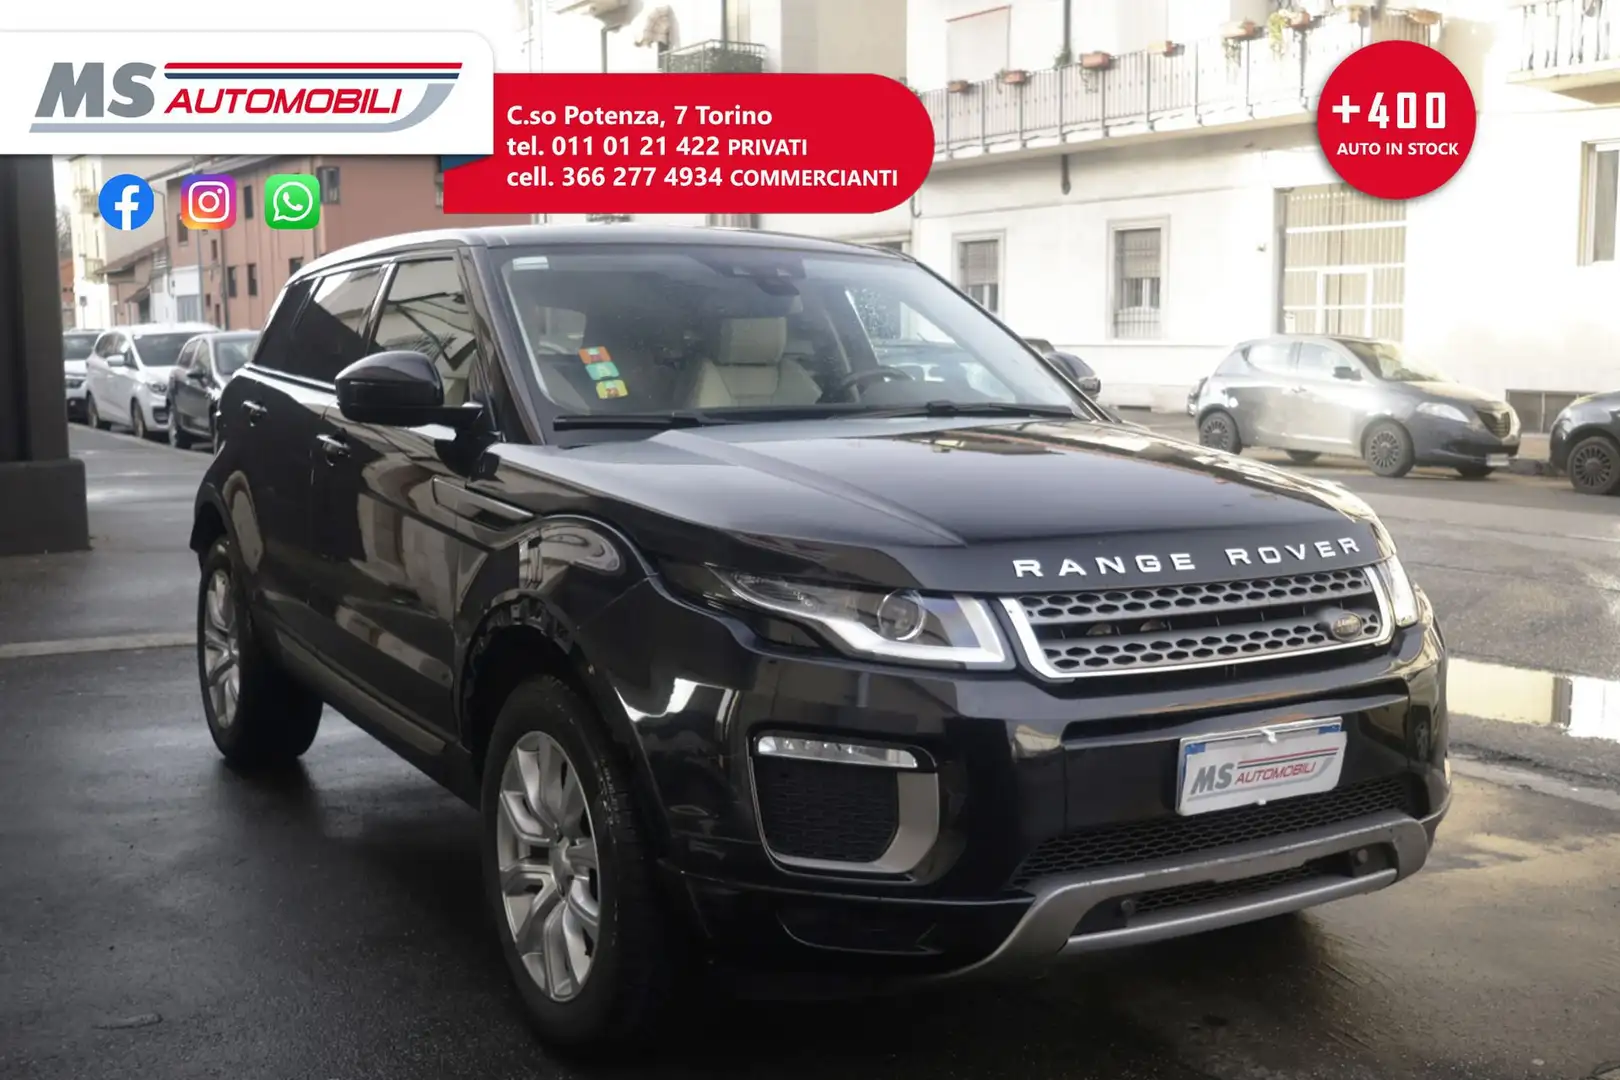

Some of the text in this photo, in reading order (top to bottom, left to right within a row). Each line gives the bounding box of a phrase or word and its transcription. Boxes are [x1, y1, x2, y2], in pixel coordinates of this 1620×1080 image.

[1012, 537, 1361, 578] RANGE ROVER
[1190, 761, 1317, 796] MS AUTOMOBILI
